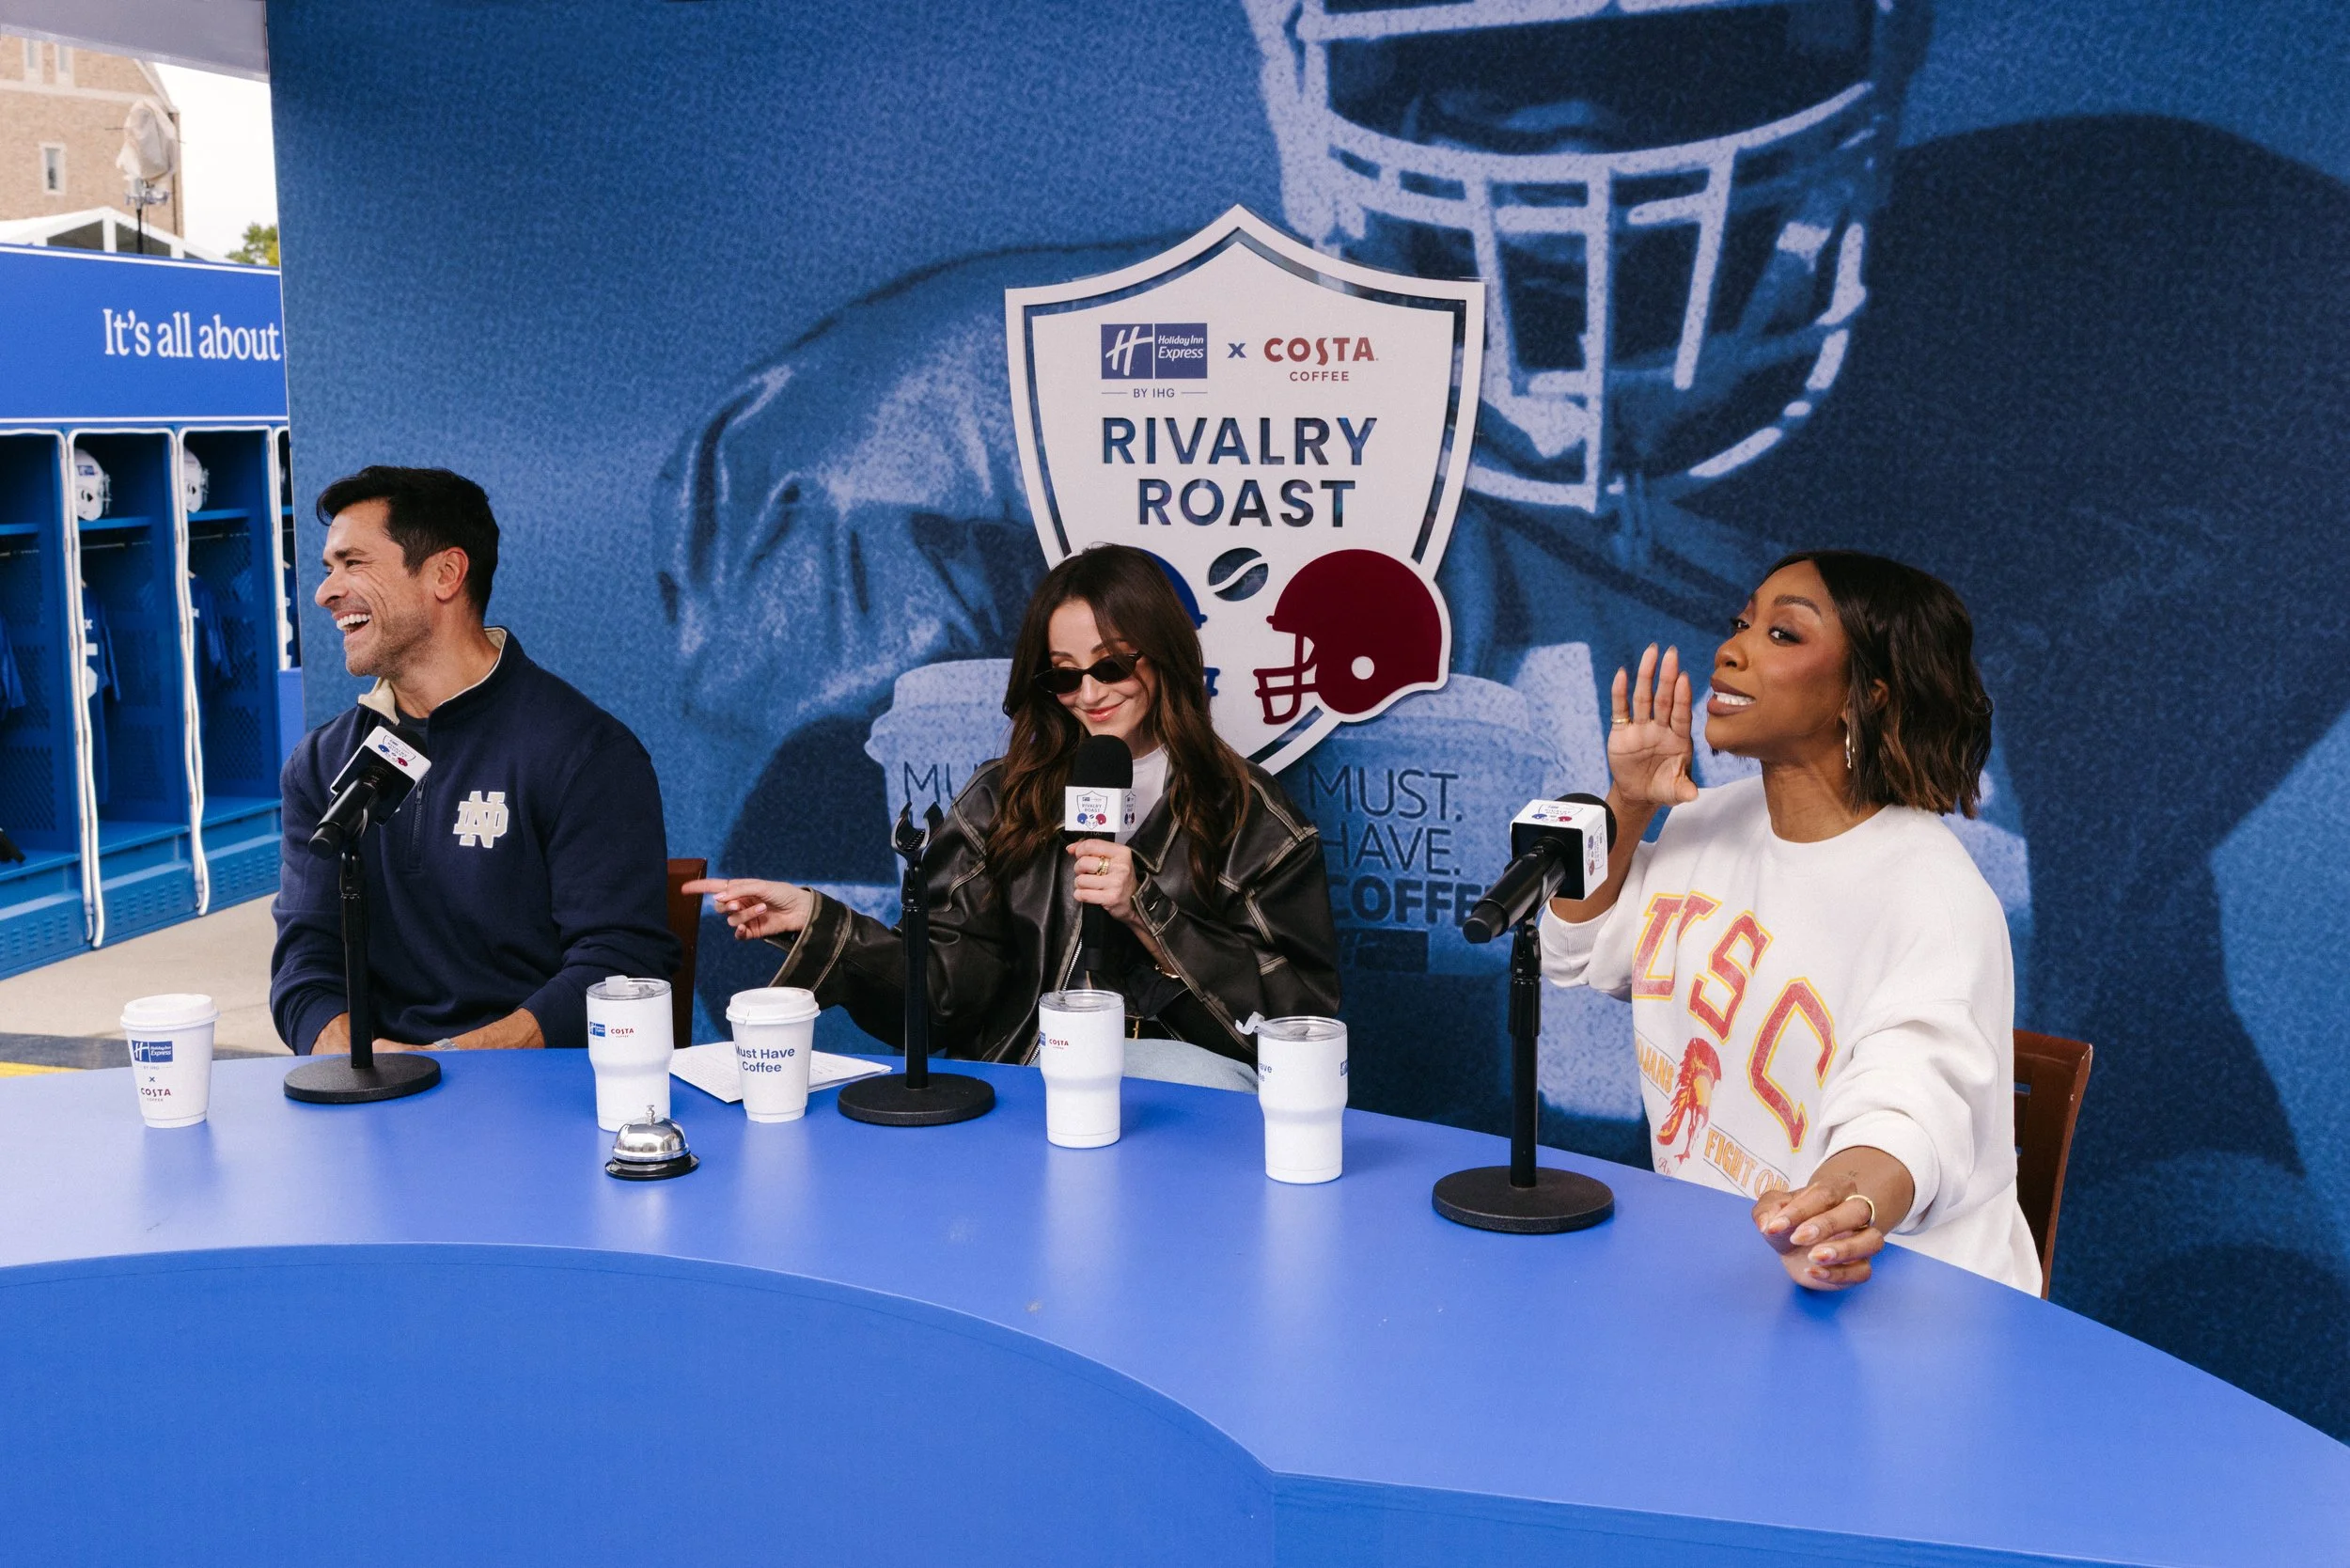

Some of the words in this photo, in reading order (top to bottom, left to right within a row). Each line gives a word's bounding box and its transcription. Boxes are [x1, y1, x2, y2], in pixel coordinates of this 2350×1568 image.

[102, 308, 151, 357] It's
[157, 311, 194, 358] all
[198, 314, 281, 361] about
[1157, 335, 1190, 348] Holiday
[1190, 336, 1204, 345] Inn
[1157, 347, 1204, 362] Express
[1263, 337, 1375, 366] COSTA
[1290, 371, 1350, 382] COFFEE
[1133, 388, 1148, 398] BY
[1152, 388, 1175, 398] IHG
[1102, 416, 1378, 466] RIVALRY
[1137, 478, 1356, 527] ROAST
[1308, 763, 1463, 823] MUST.
[1327, 874, 1496, 927] COFFE
[1632, 891, 1837, 1153] USC
[735, 1045, 758, 1058] Must
[760, 1047, 795, 1059] Have
[742, 1060, 782, 1073] Coffee
[141, 1088, 171, 1097] COSTA
[1703, 1128, 1759, 1189] FIGHT
